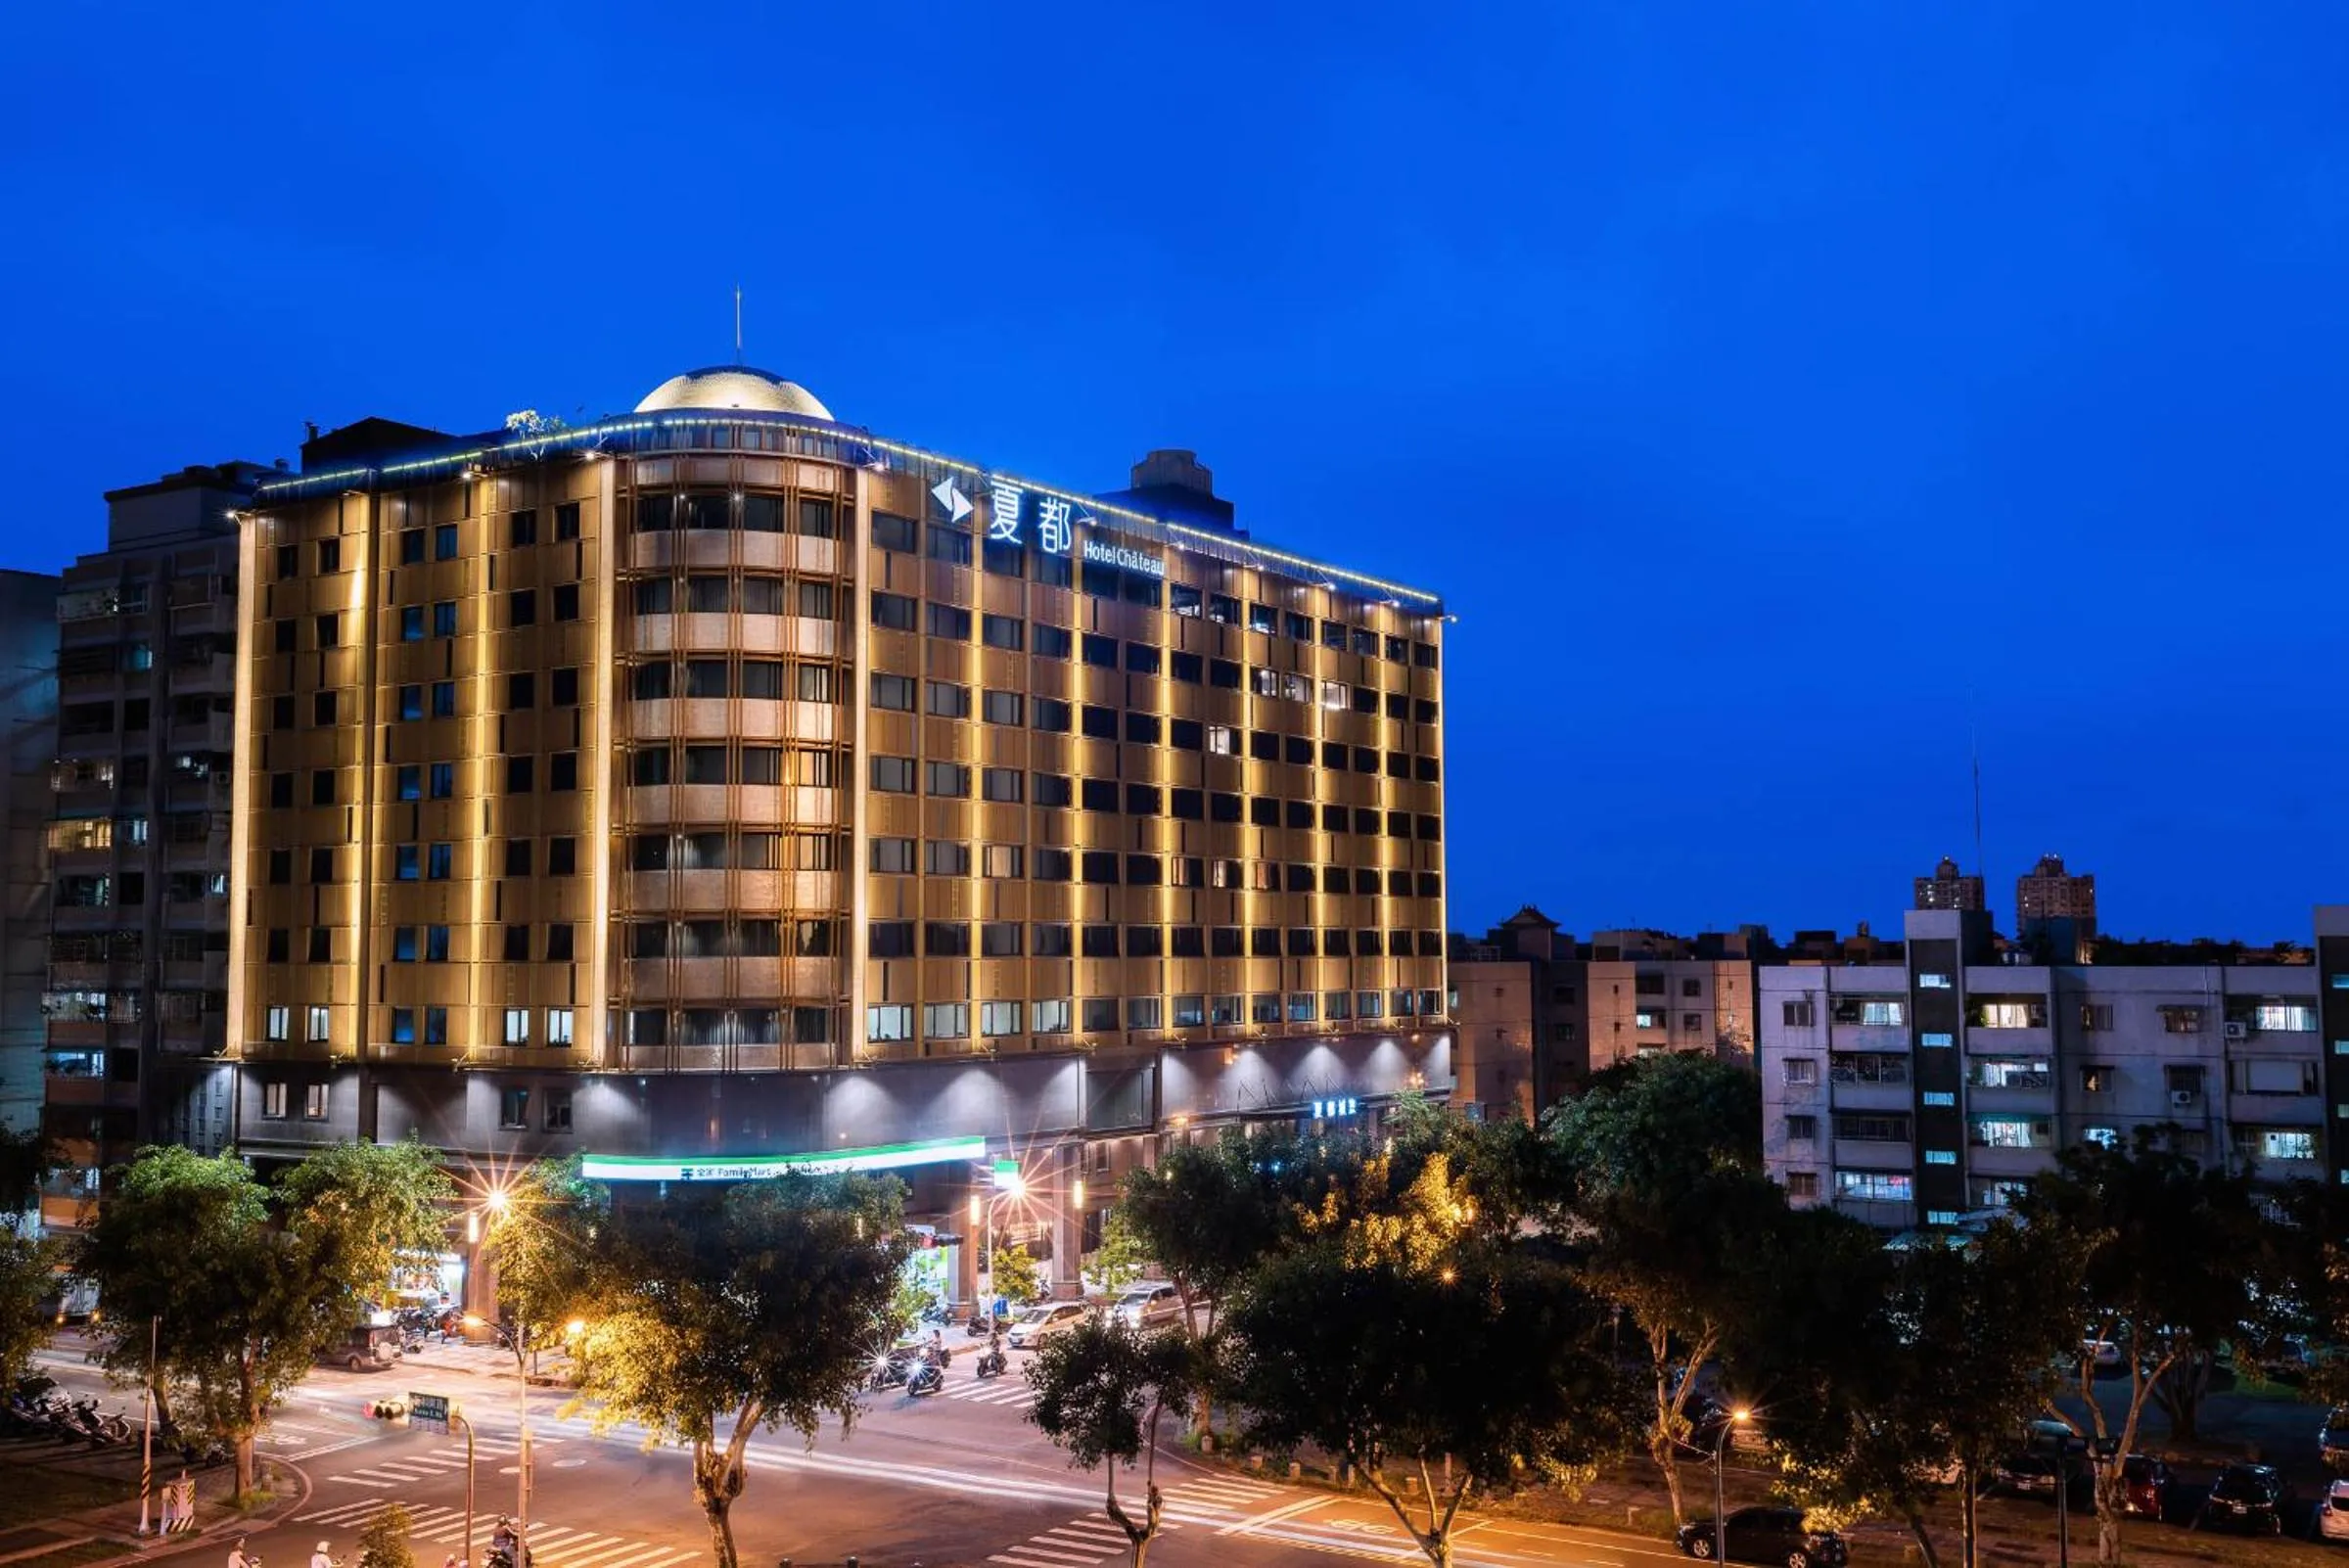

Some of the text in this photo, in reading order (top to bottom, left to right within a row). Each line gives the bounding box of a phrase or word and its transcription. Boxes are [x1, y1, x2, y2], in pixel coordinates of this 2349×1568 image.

[990, 480, 1072, 554] 夏都
[1083, 539, 1165, 576] Hotel Château
